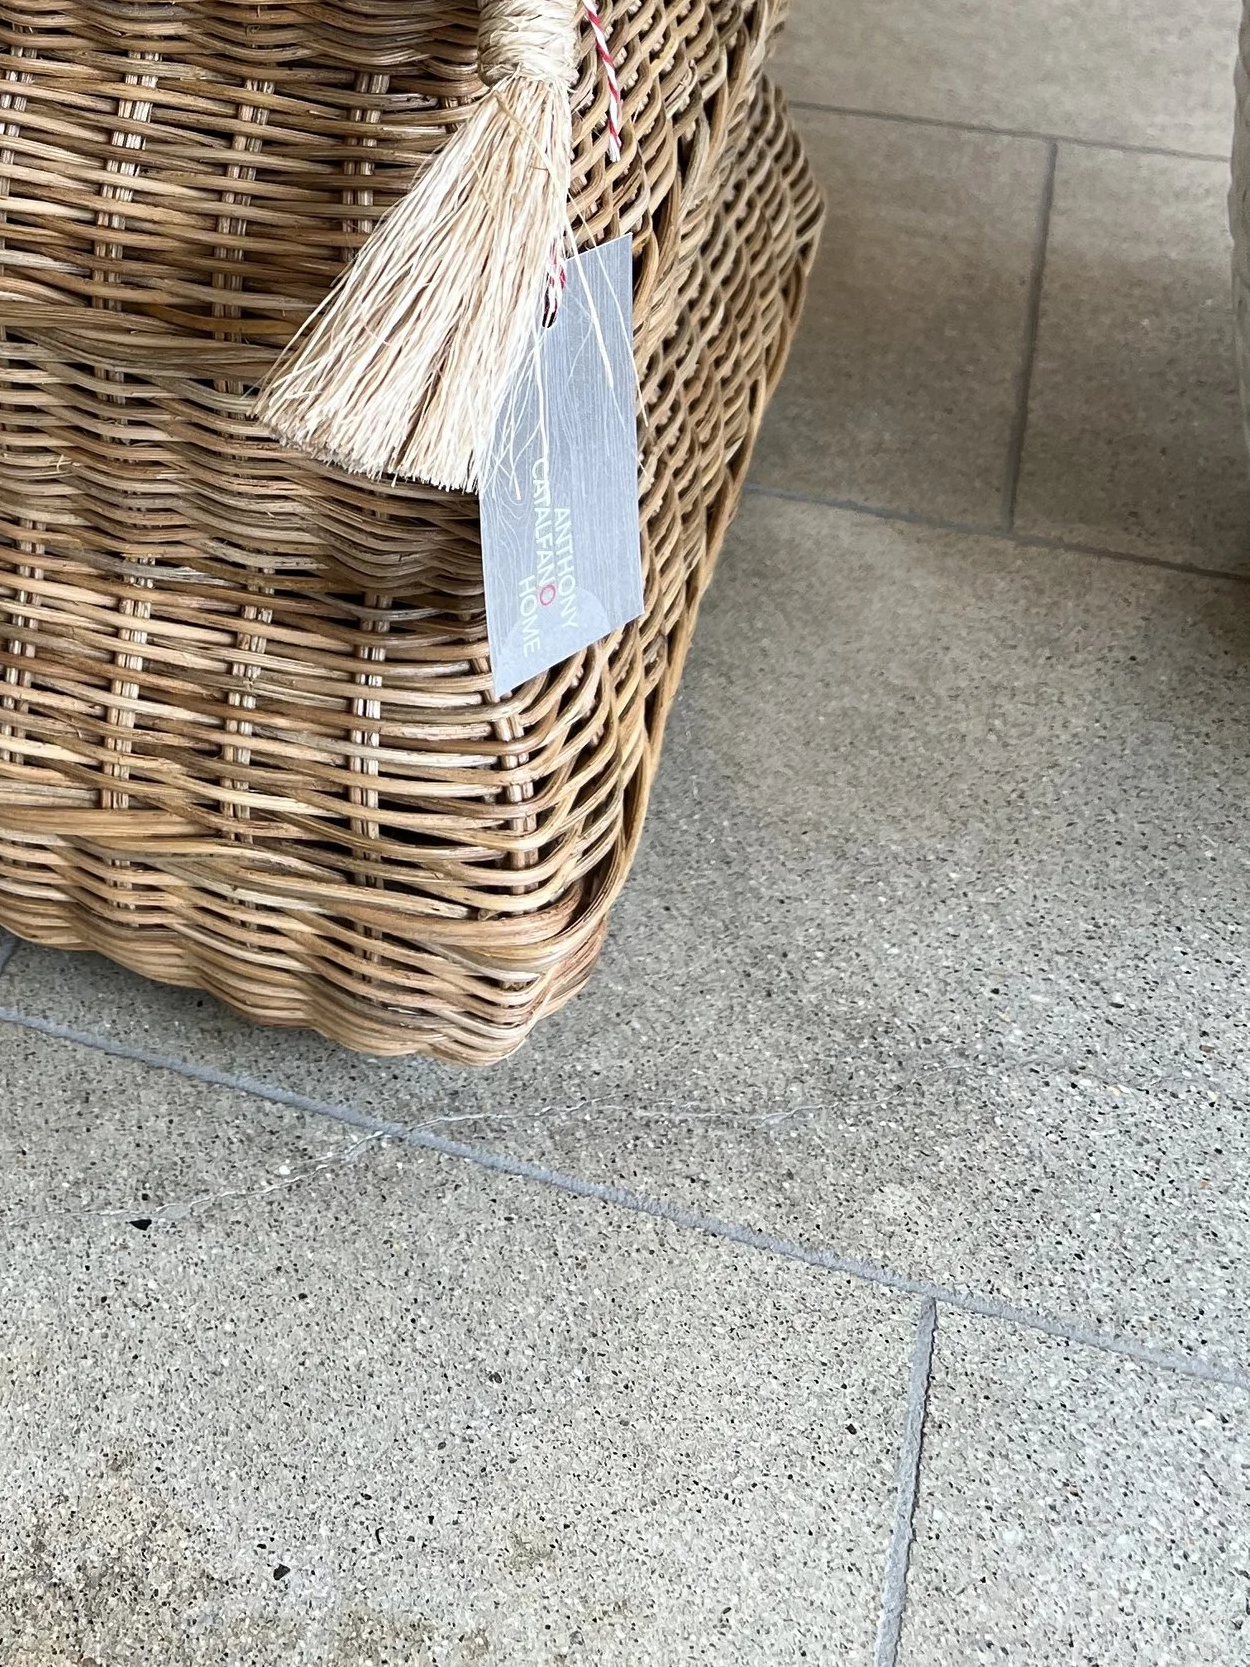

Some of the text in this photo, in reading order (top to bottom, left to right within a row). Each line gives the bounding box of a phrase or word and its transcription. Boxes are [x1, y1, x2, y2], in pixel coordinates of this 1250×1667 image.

[532, 458, 557, 607] CATALFANO
[554, 507, 579, 629] ANTHONY
[518, 574, 541, 658] HOME
